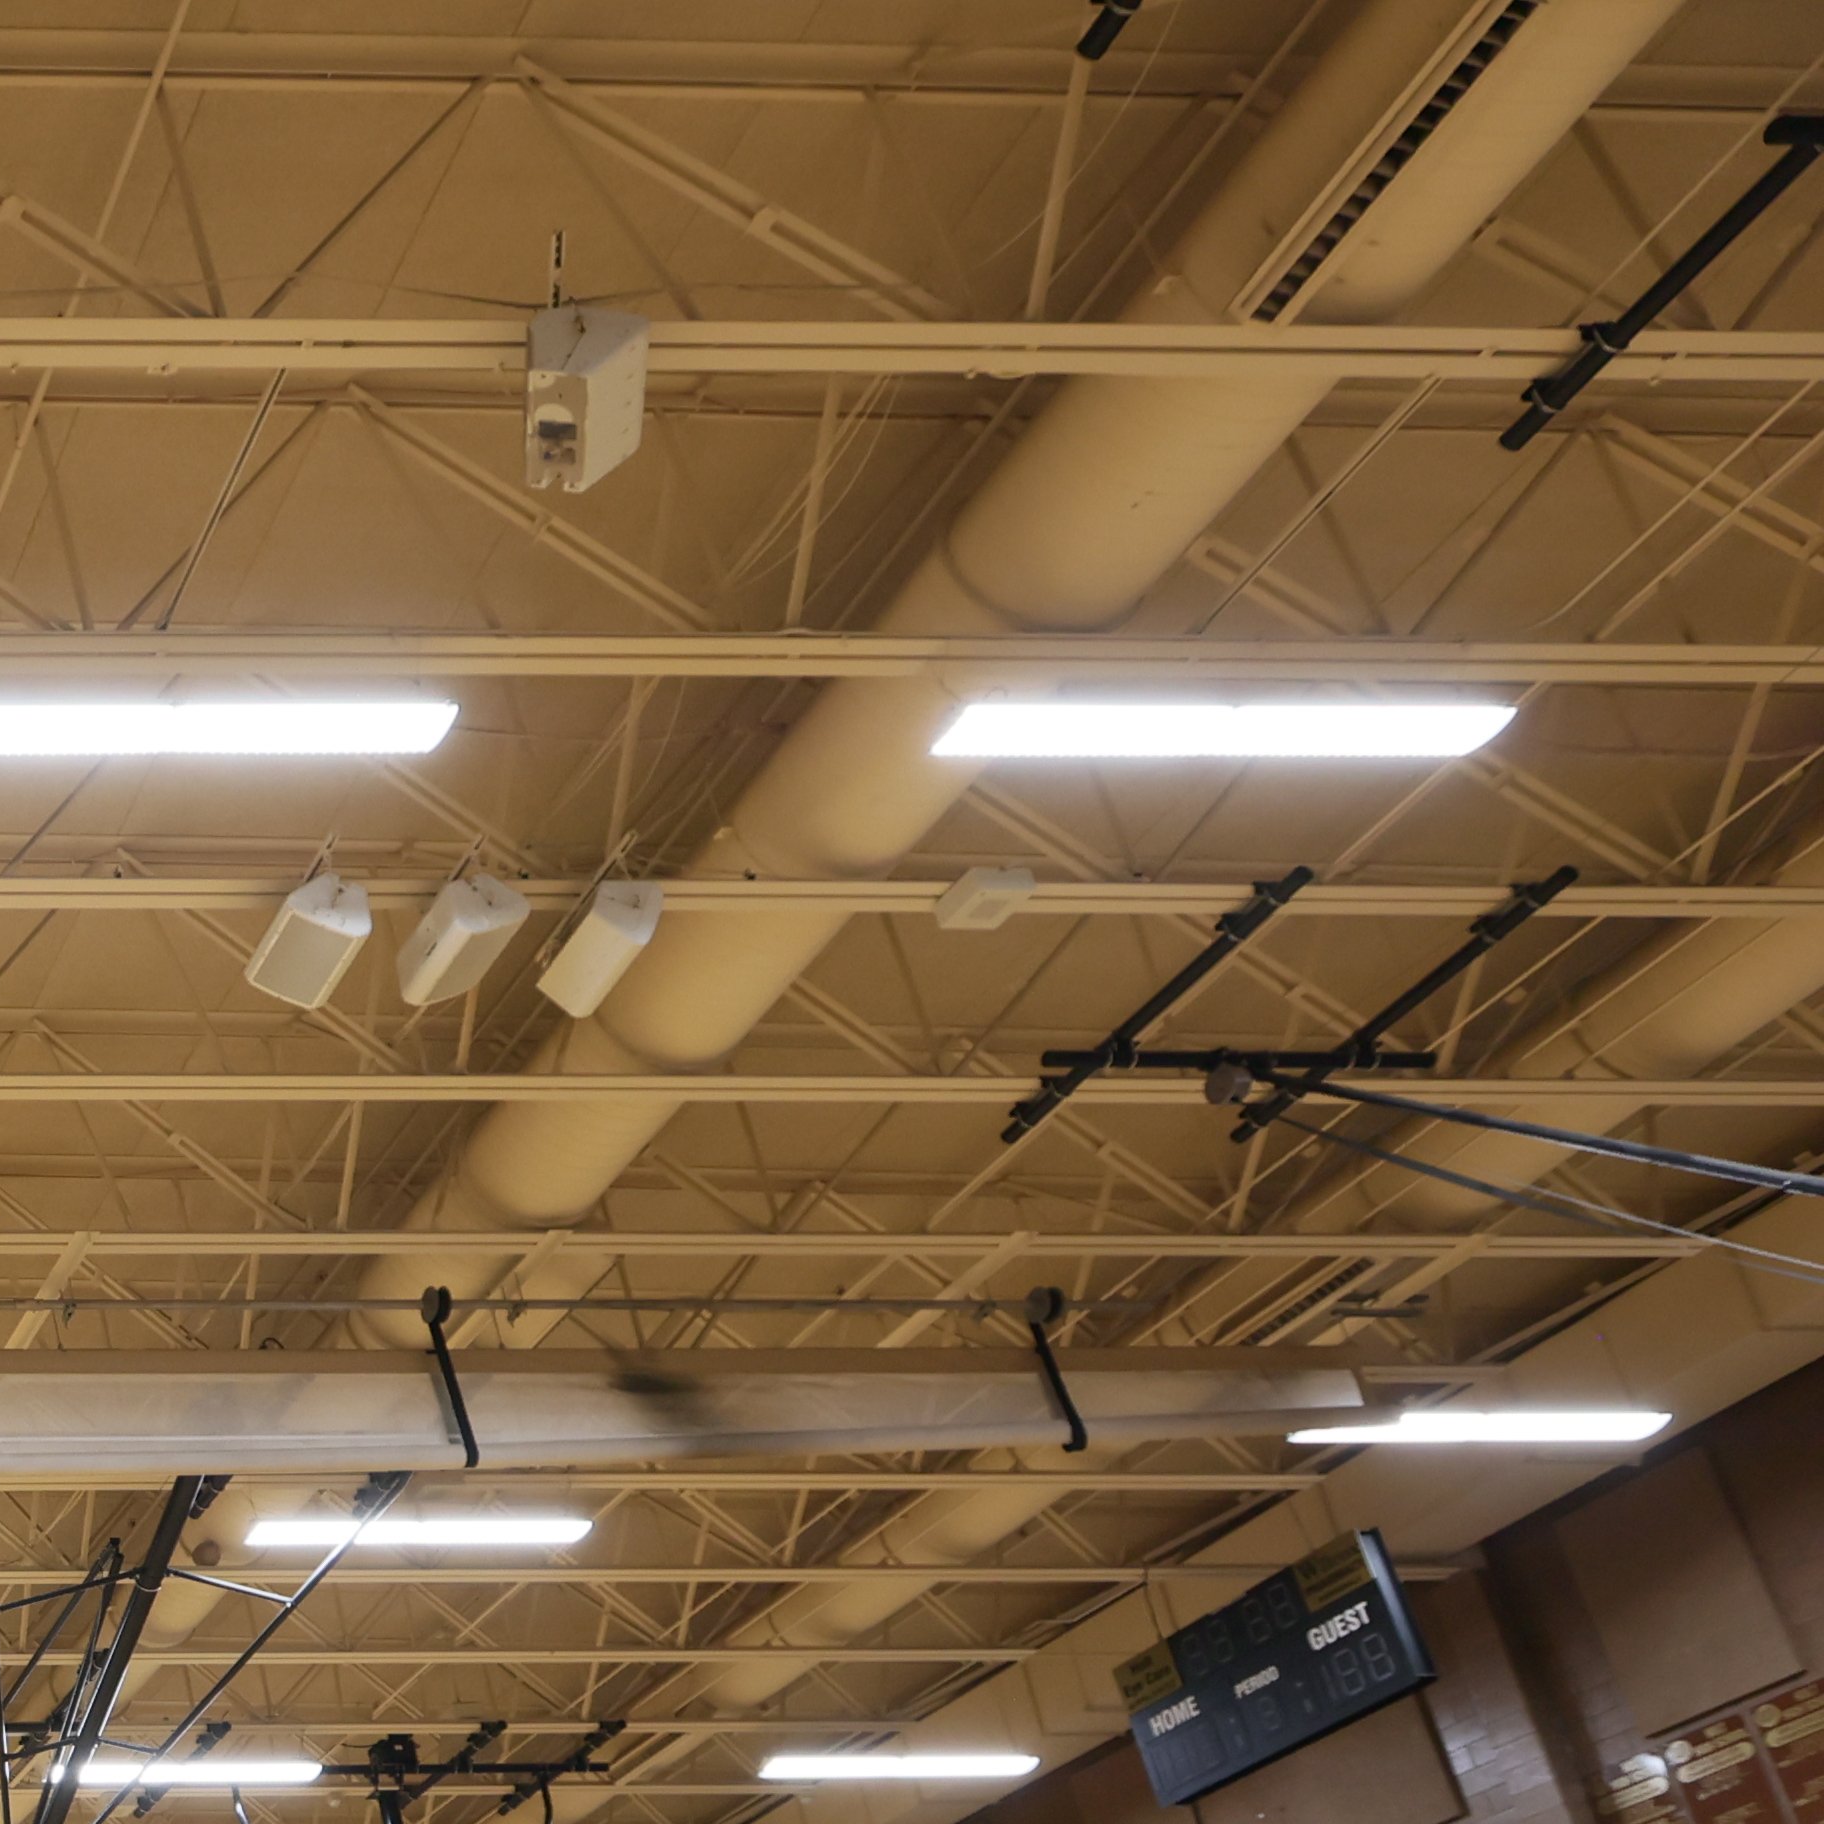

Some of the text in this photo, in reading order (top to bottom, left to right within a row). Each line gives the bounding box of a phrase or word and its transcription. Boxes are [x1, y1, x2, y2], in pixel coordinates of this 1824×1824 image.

[1306, 1601, 1371, 1651] GUEST
[1234, 1666, 1280, 1698] PERIOD
[1149, 1695, 1201, 1737] HOME
